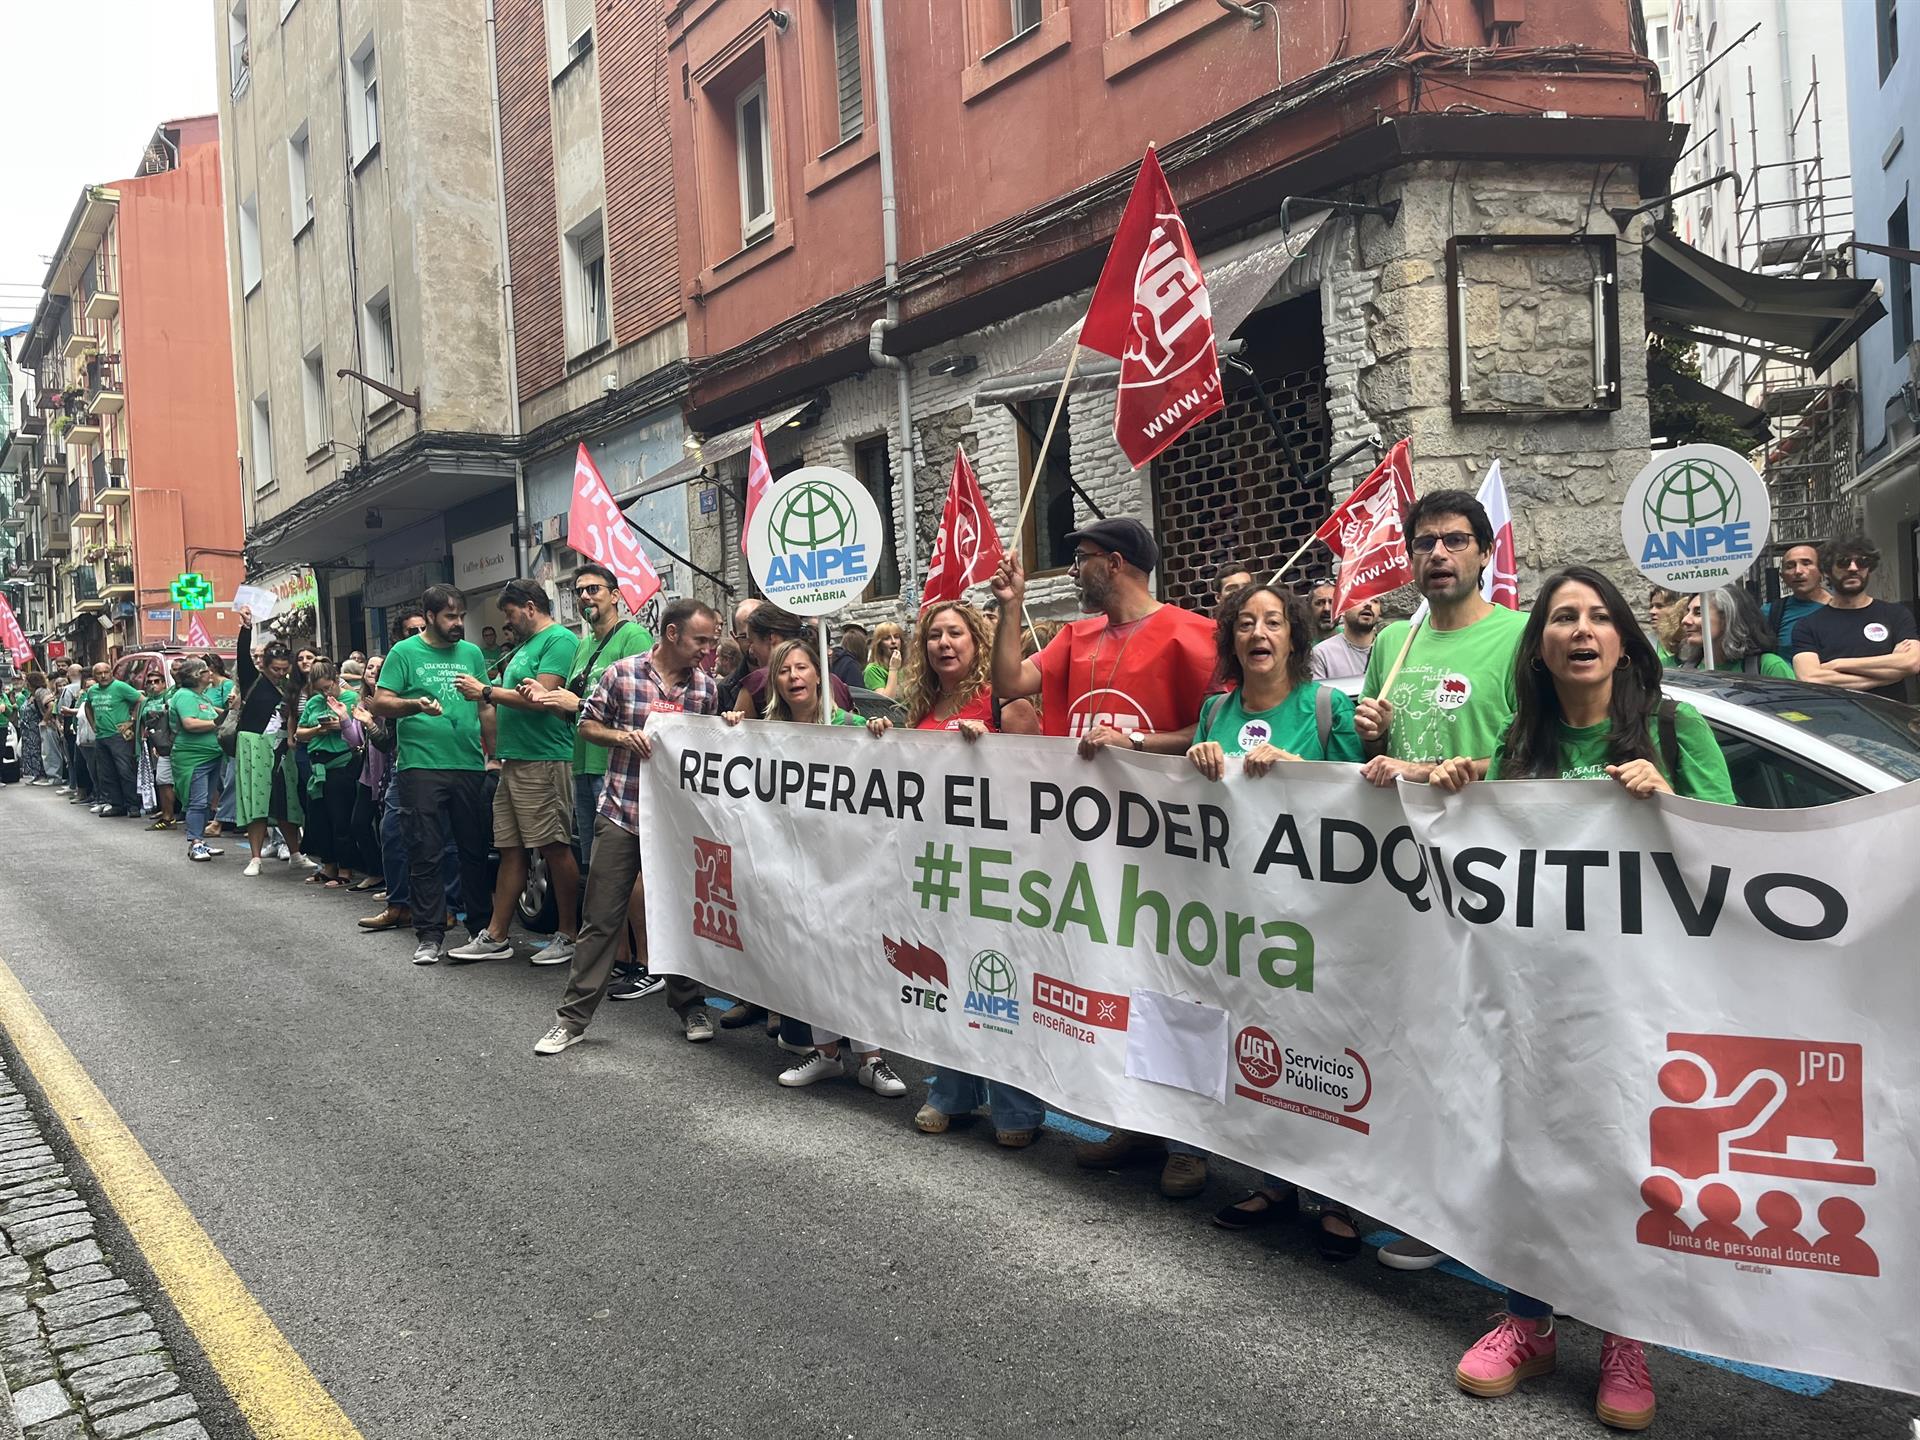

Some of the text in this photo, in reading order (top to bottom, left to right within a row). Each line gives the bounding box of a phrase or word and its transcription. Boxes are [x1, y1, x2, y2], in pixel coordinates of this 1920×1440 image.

[1142, 367, 1221, 439] www.u
[1641, 521, 1753, 562] ANPE
[765, 544, 868, 587] ANPE
[1340, 555, 1409, 595] www.ug
[1641, 552, 1753, 570] SINDICATO INDEPENDIENTE
[1666, 567, 1729, 581] CANTABRIA
[765, 575, 868, 594] SINDICATO INDEPENDIENTE
[789, 590, 847, 605] CANTABRIA
[1439, 694, 1464, 704] STEC
[680, 748, 1849, 941] RECUPERAR EL PODER ADQISITIVO
[913, 841, 1315, 993] #EsAhora
[901, 985, 948, 1013] STEC
[964, 990, 1020, 1021] ANPE
[1037, 980, 1088, 1017] CCOO
[1032, 1010, 1096, 1045] enseñanza
[1240, 1033, 1276, 1066] UGT
[1285, 1048, 1354, 1080] Servicios
[1286, 1068, 1349, 1099] Públicos
[1796, 1050, 1846, 1087] JPD
[1262, 1094, 1340, 1124] Enseñanza Cantabria
[1668, 1230, 1841, 1267] Junta de personal docente
[1735, 1262, 1772, 1276] Cantabria
